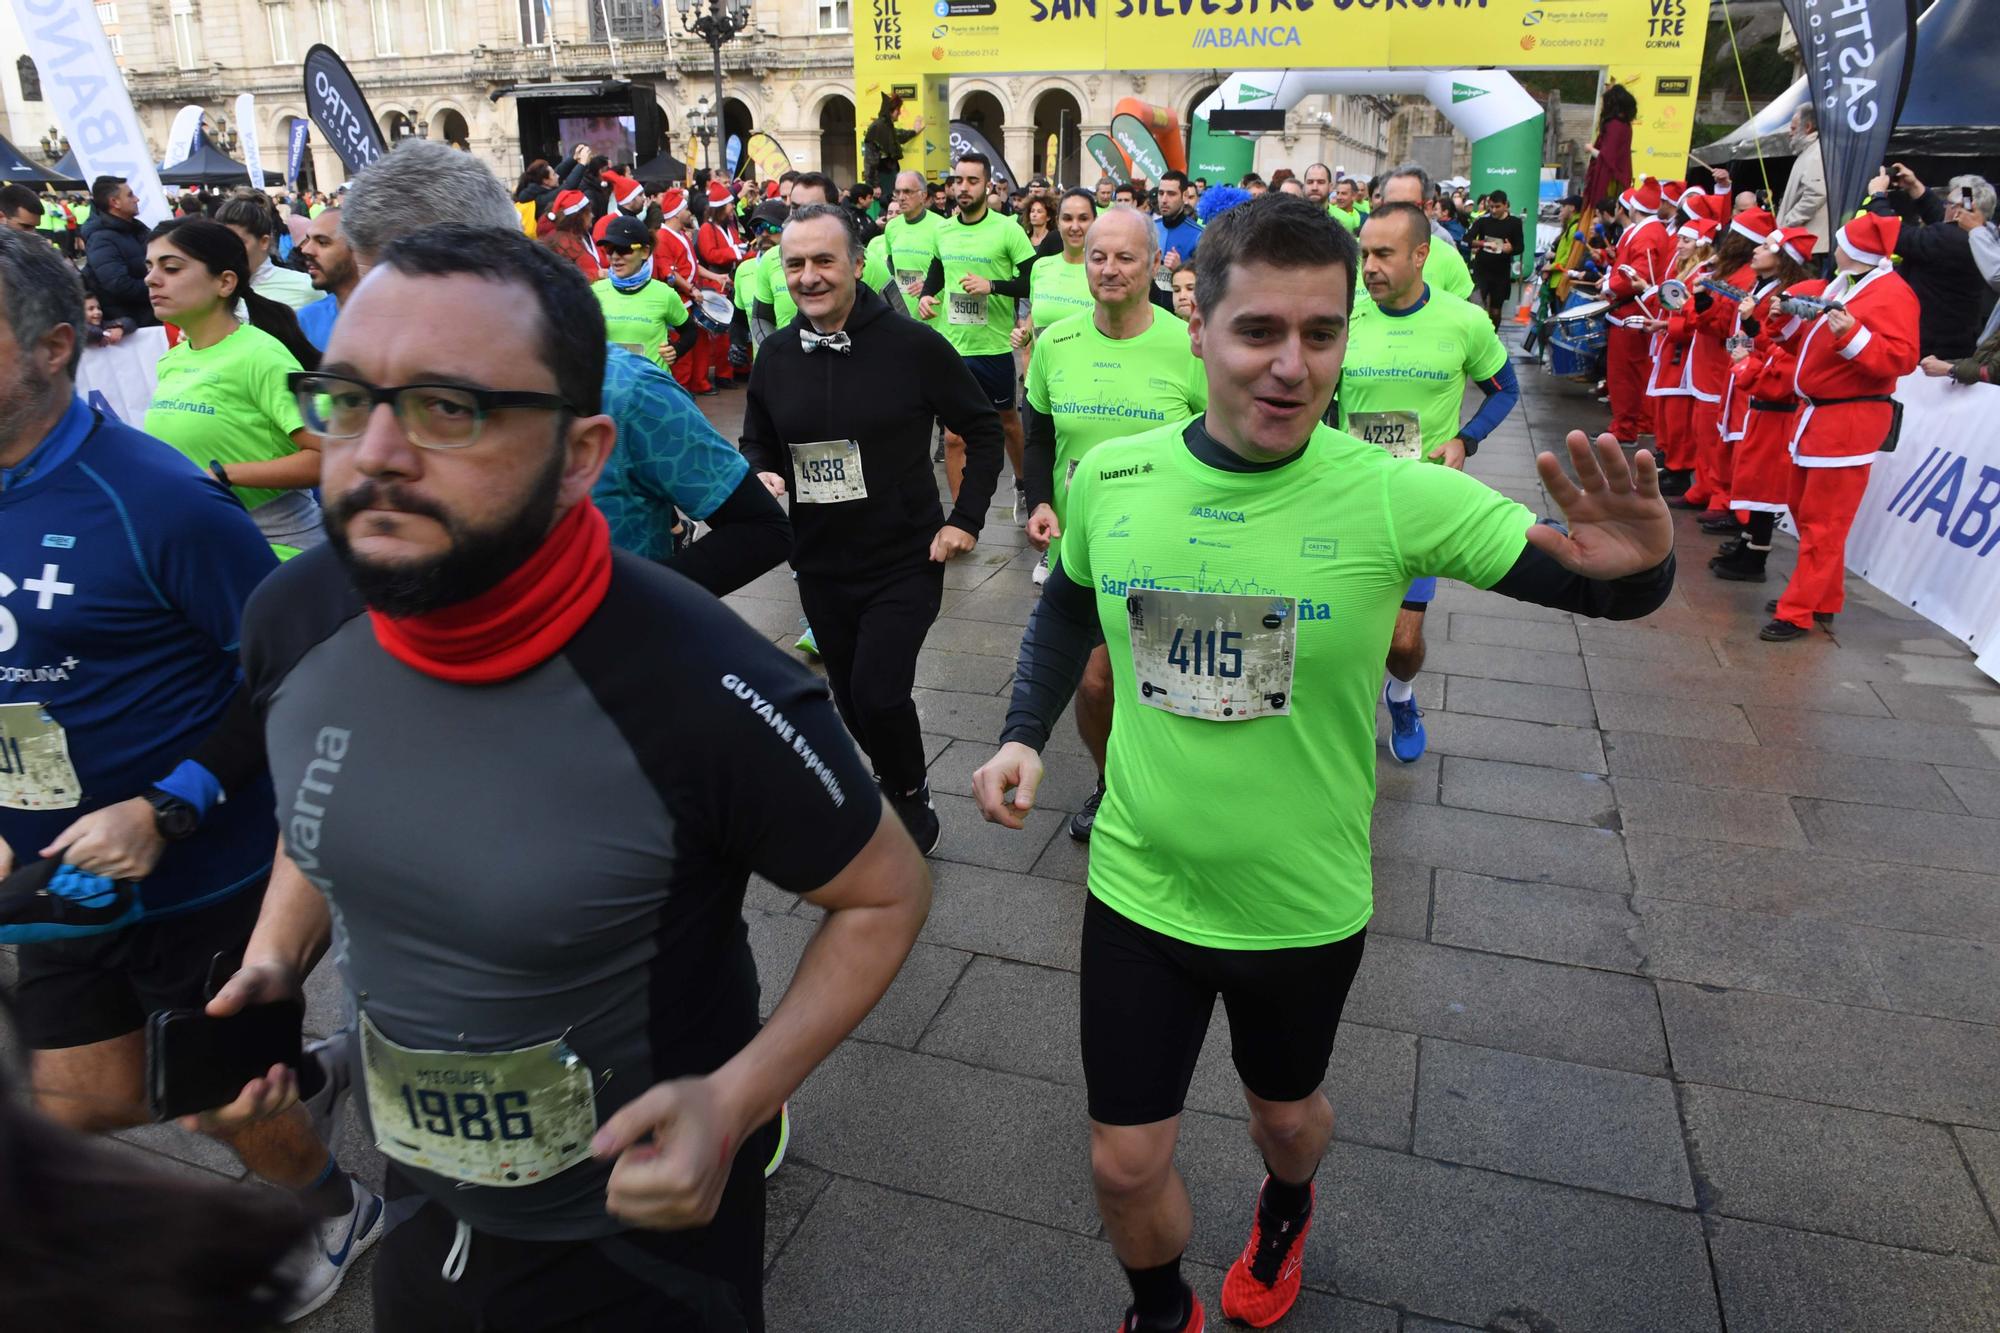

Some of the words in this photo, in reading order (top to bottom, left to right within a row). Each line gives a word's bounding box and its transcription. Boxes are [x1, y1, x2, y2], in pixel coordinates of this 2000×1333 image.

[873, 17, 902, 34] VES
[1648, 18, 1685, 37] TRE
[874, 35, 902, 51] TRE
[954, 301, 979, 315] 3500
[1363, 424, 1405, 445] 4232
[802, 458, 846, 483] 4338
[1100, 464, 1139, 482] luanvi
[1308, 543, 1332, 551] CASTRO
[1167, 628, 1243, 679] 4115
[721, 674, 796, 743] GUYANE
[792, 734, 846, 808] Expedition
[417, 1069, 496, 1086] MIGUEL
[402, 1084, 534, 1142] 1986
